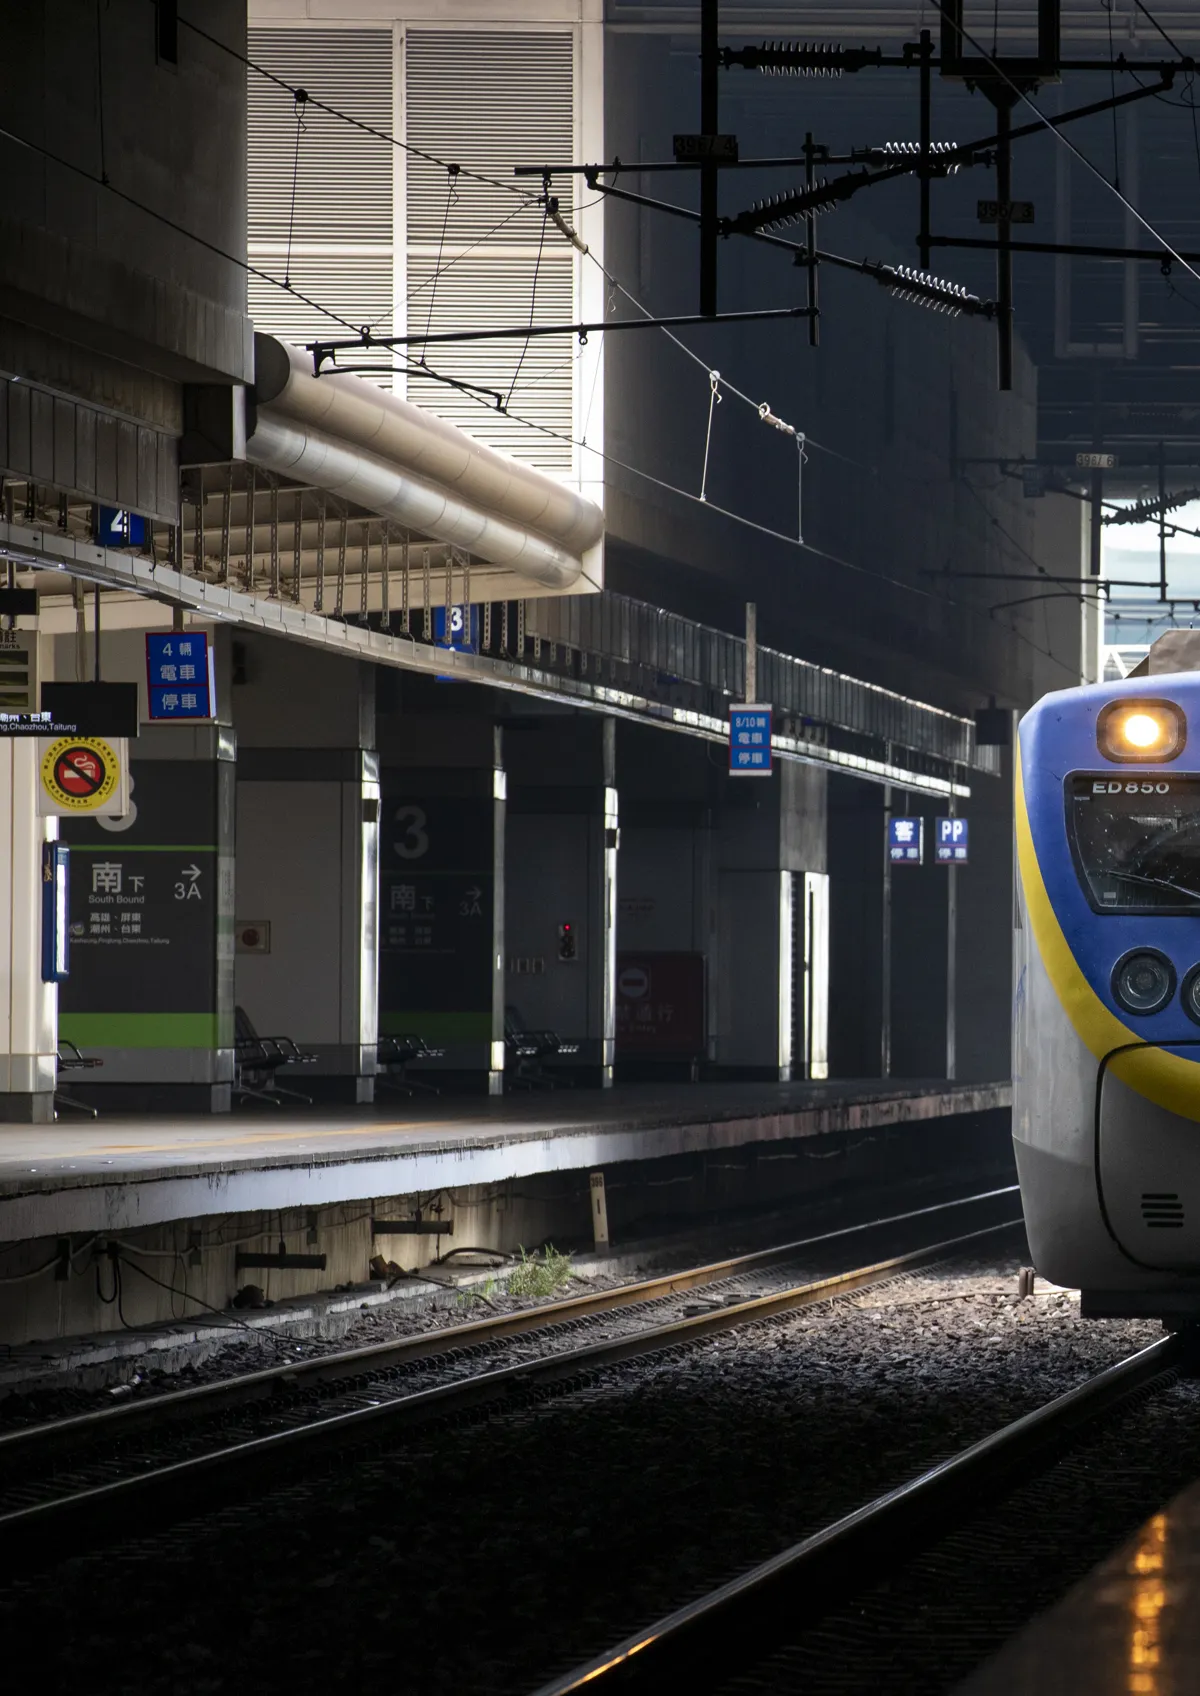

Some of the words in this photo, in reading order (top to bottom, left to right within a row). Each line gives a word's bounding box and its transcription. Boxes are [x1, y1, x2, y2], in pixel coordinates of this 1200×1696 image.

[450, 606, 463, 632] 3
[160, 664, 196, 681] 電車
[162, 692, 198, 710] 停車
[393, 805, 430, 860] 3
[941, 820, 963, 842] PP
[88, 894, 114, 904] South
[116, 894, 145, 904] Bound
[174, 882, 202, 900] 3A
[459, 901, 482, 917] 3A
